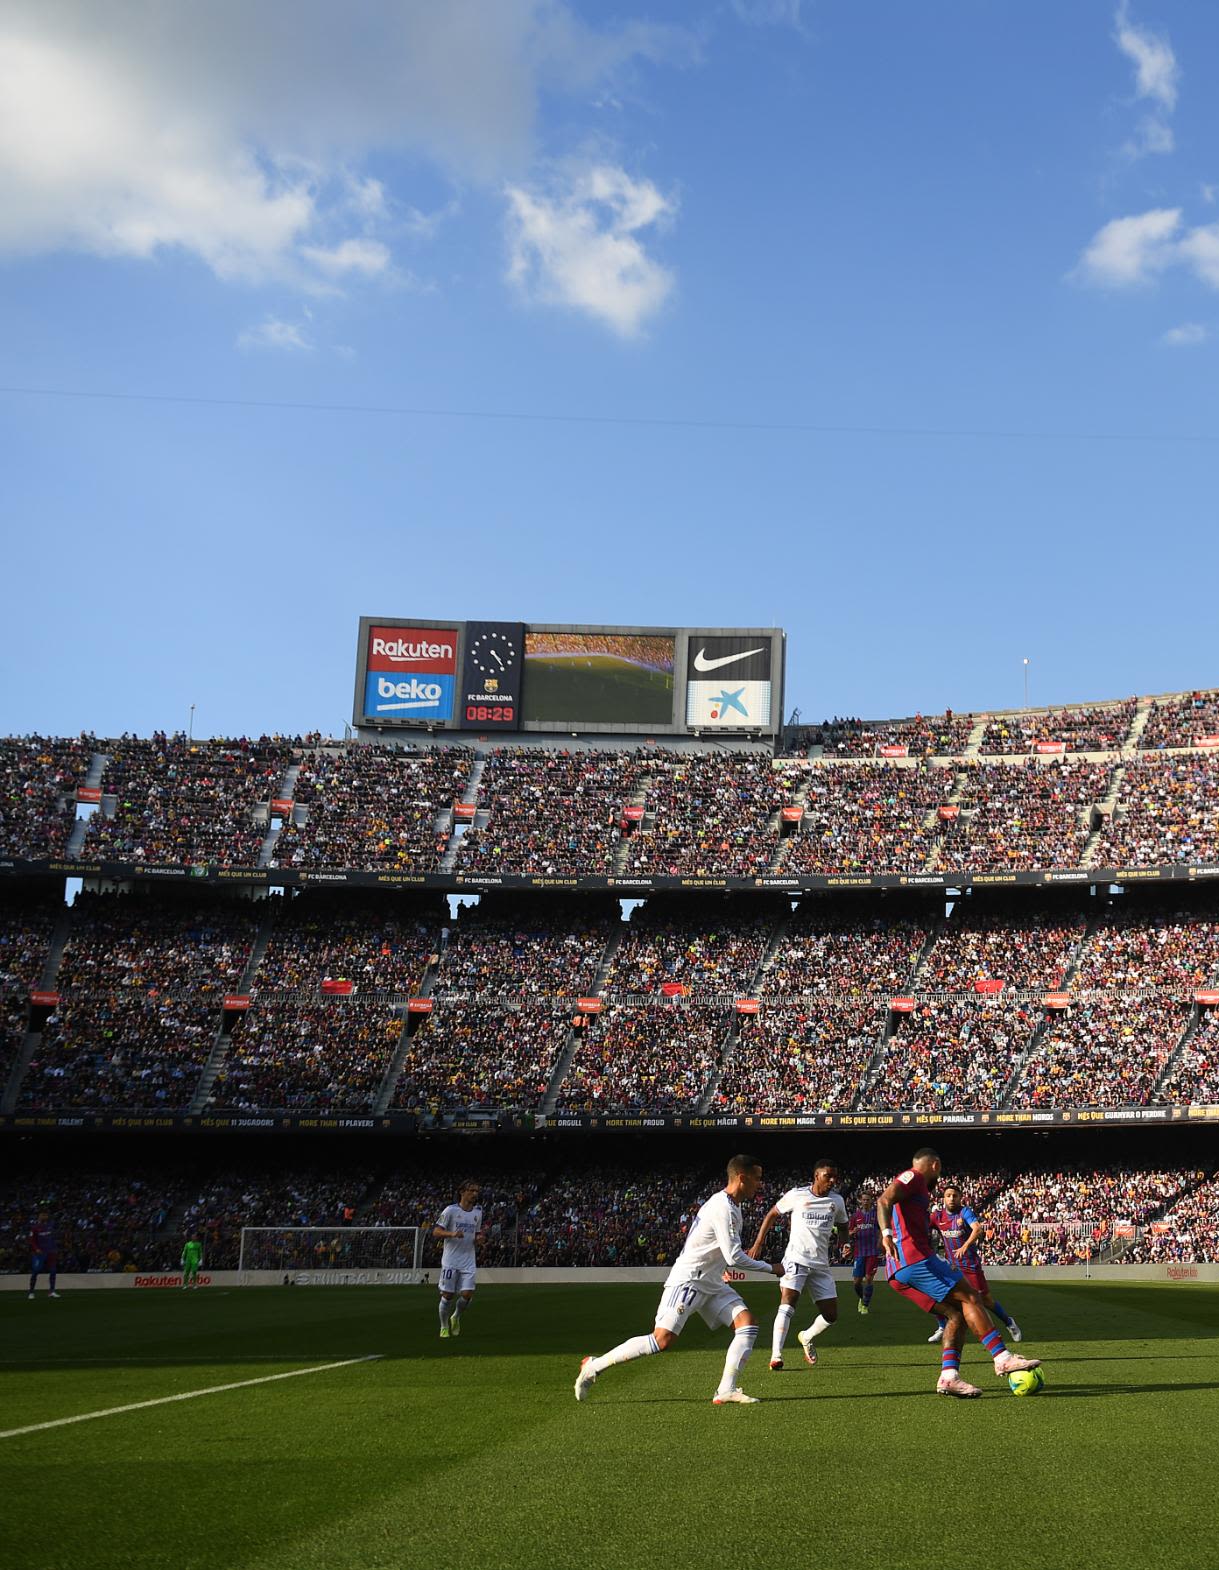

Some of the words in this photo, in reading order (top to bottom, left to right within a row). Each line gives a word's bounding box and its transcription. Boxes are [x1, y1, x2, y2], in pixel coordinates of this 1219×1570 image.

[372, 637, 453, 658] Rakuten
[378, 677, 442, 700] beko
[476, 694, 513, 702] BARCELONA
[466, 706, 513, 721] 08:29
[853, 1117, 867, 1125] QUE
[877, 1116, 893, 1124] CLUB
[929, 1116, 943, 1124] QUE
[996, 1114, 1014, 1122] MORE
[442, 1269, 453, 1280] 10
[135, 1276, 182, 1286] Rakuten
[683, 1286, 697, 1307] 17
